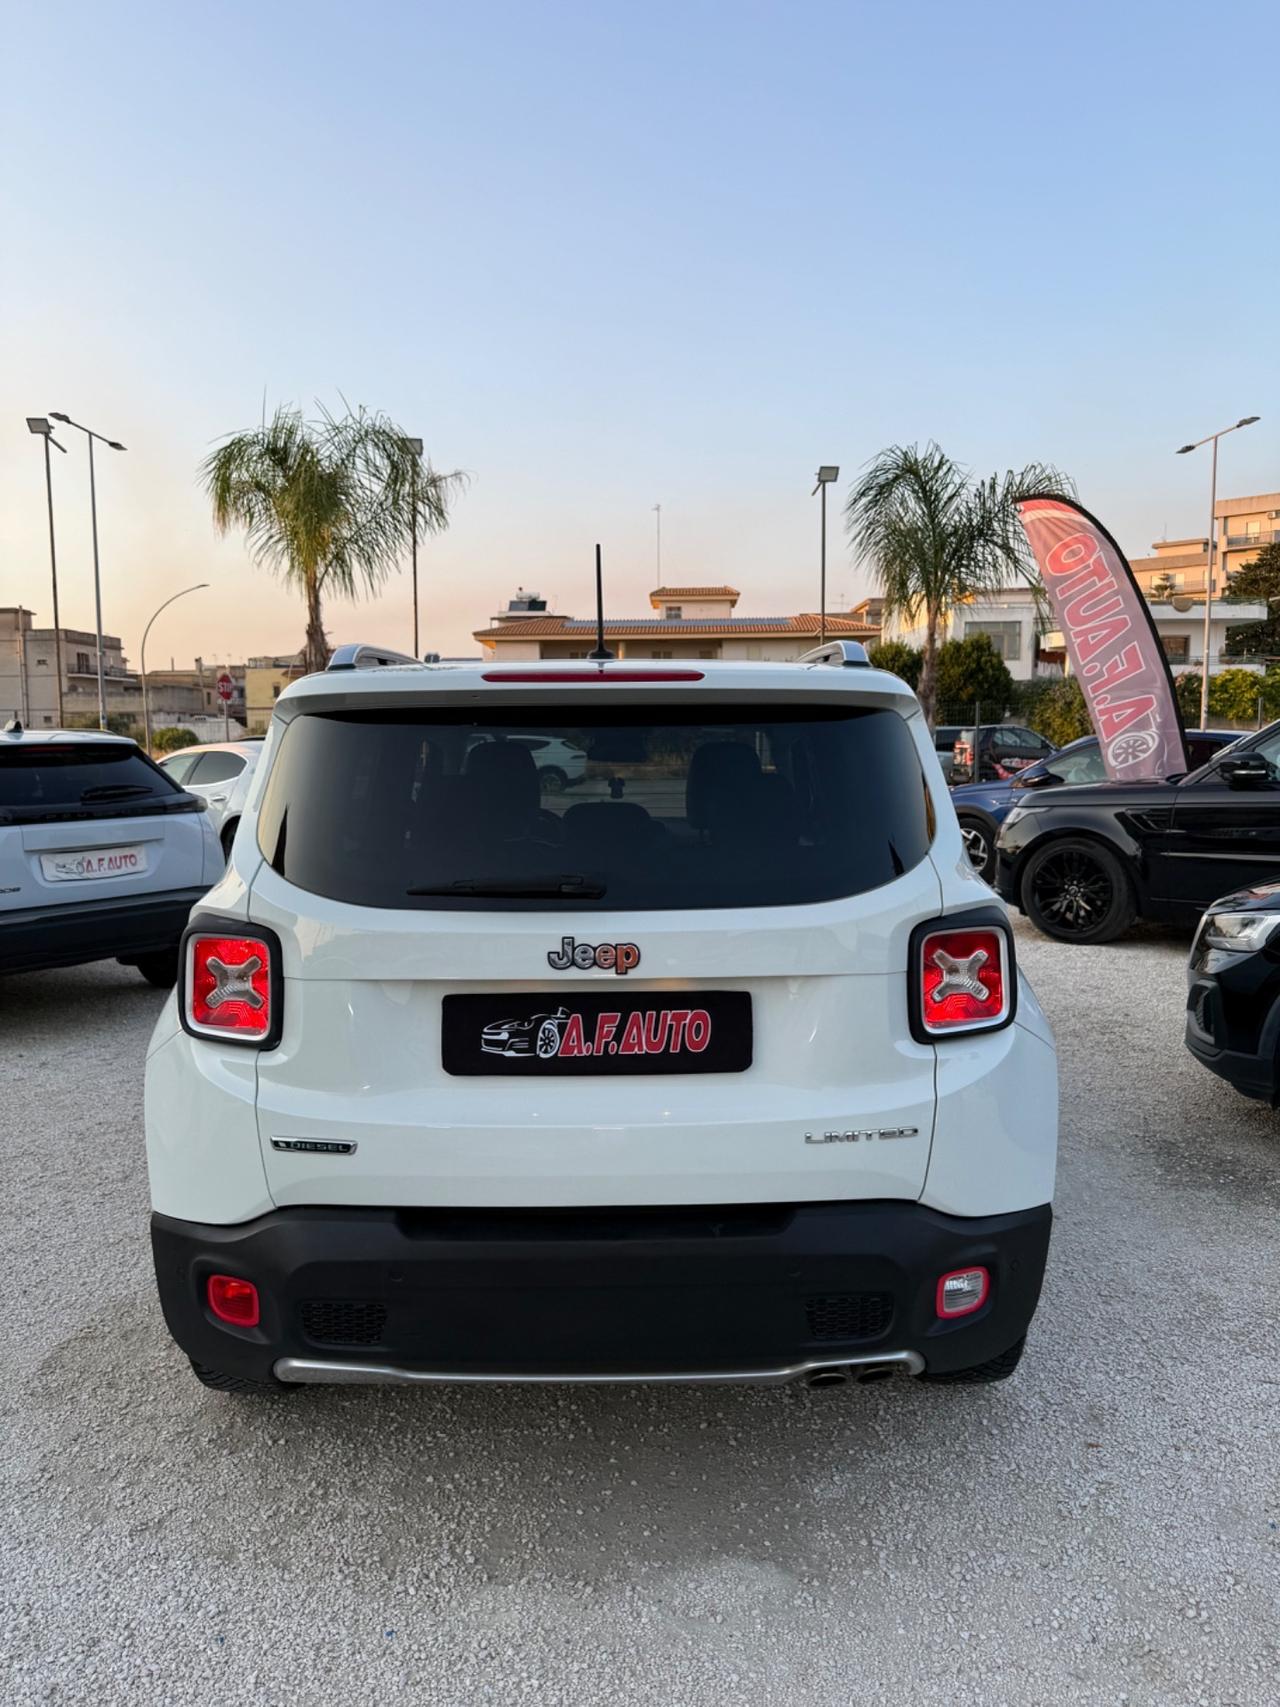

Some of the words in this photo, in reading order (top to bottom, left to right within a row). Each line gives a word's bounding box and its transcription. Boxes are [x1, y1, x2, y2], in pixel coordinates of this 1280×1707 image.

[85, 853, 138, 874] A.F.AUTO
[548, 936, 641, 975] Jeep
[557, 1009, 712, 1057] A.F.AUTO
[804, 1127, 919, 1144] LIMITED
[290, 1141, 349, 1152] DIESEL
